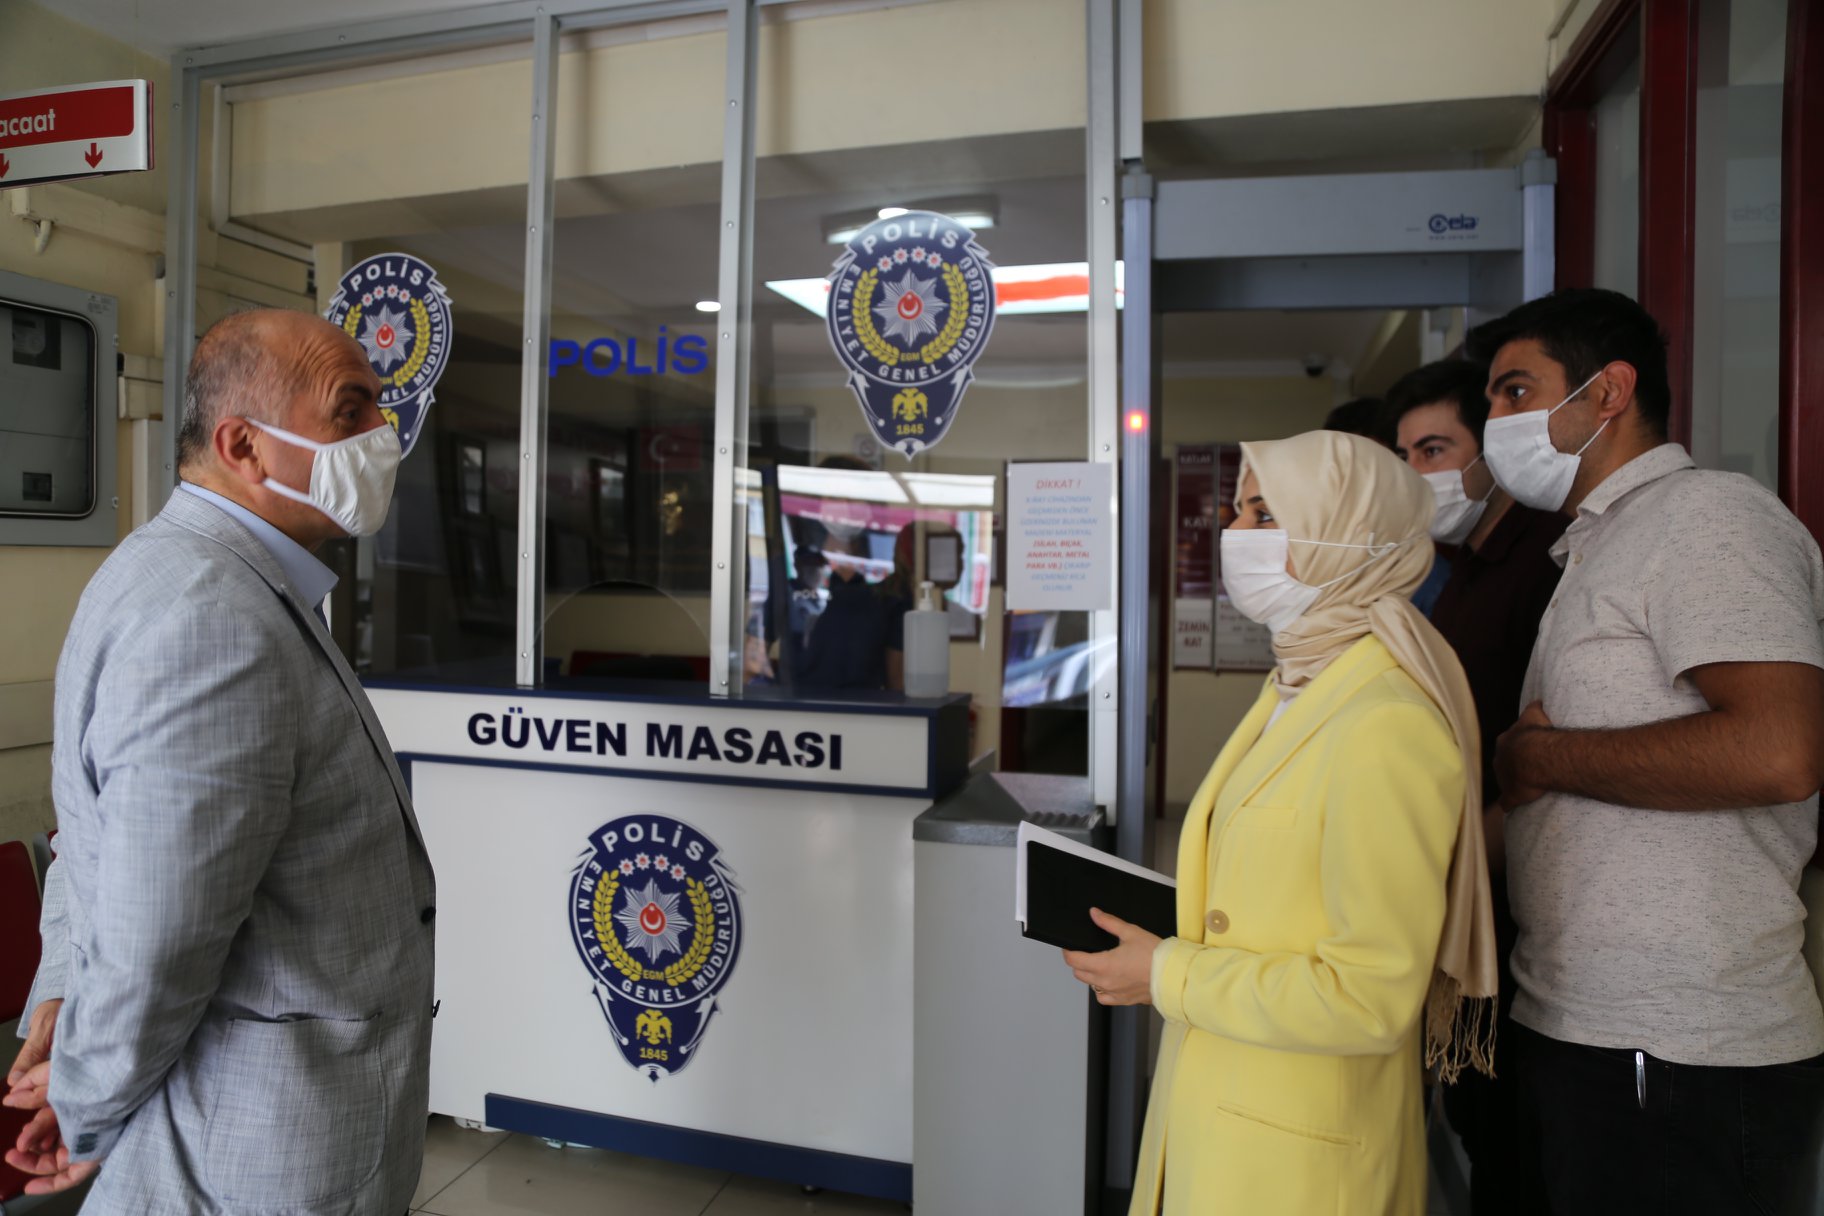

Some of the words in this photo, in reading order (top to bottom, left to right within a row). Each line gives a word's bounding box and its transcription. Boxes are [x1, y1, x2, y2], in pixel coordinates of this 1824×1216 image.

[0, 108, 56, 138] acaat
[861, 218, 959, 255] POLİS
[350, 259, 425, 292] POLİS
[548, 325, 709, 378] POLİS
[900, 351, 921, 363] EGM
[878, 363, 942, 382] GENEL
[381, 386, 409, 402] NEL
[896, 423, 925, 437] 1845
[1036, 479, 1074, 489] DİKKAT
[1184, 636, 1203, 649] KAT
[467, 707, 628, 757] GÜVEN
[646, 722, 843, 771] MASASI
[601, 823, 705, 862] POLİS
[691, 873, 731, 991] MÜDÜRLÜĞÜ
[642, 968, 665, 982] EGM
[620, 978, 687, 1003] GENEL
[639, 1047, 669, 1062] 1845
